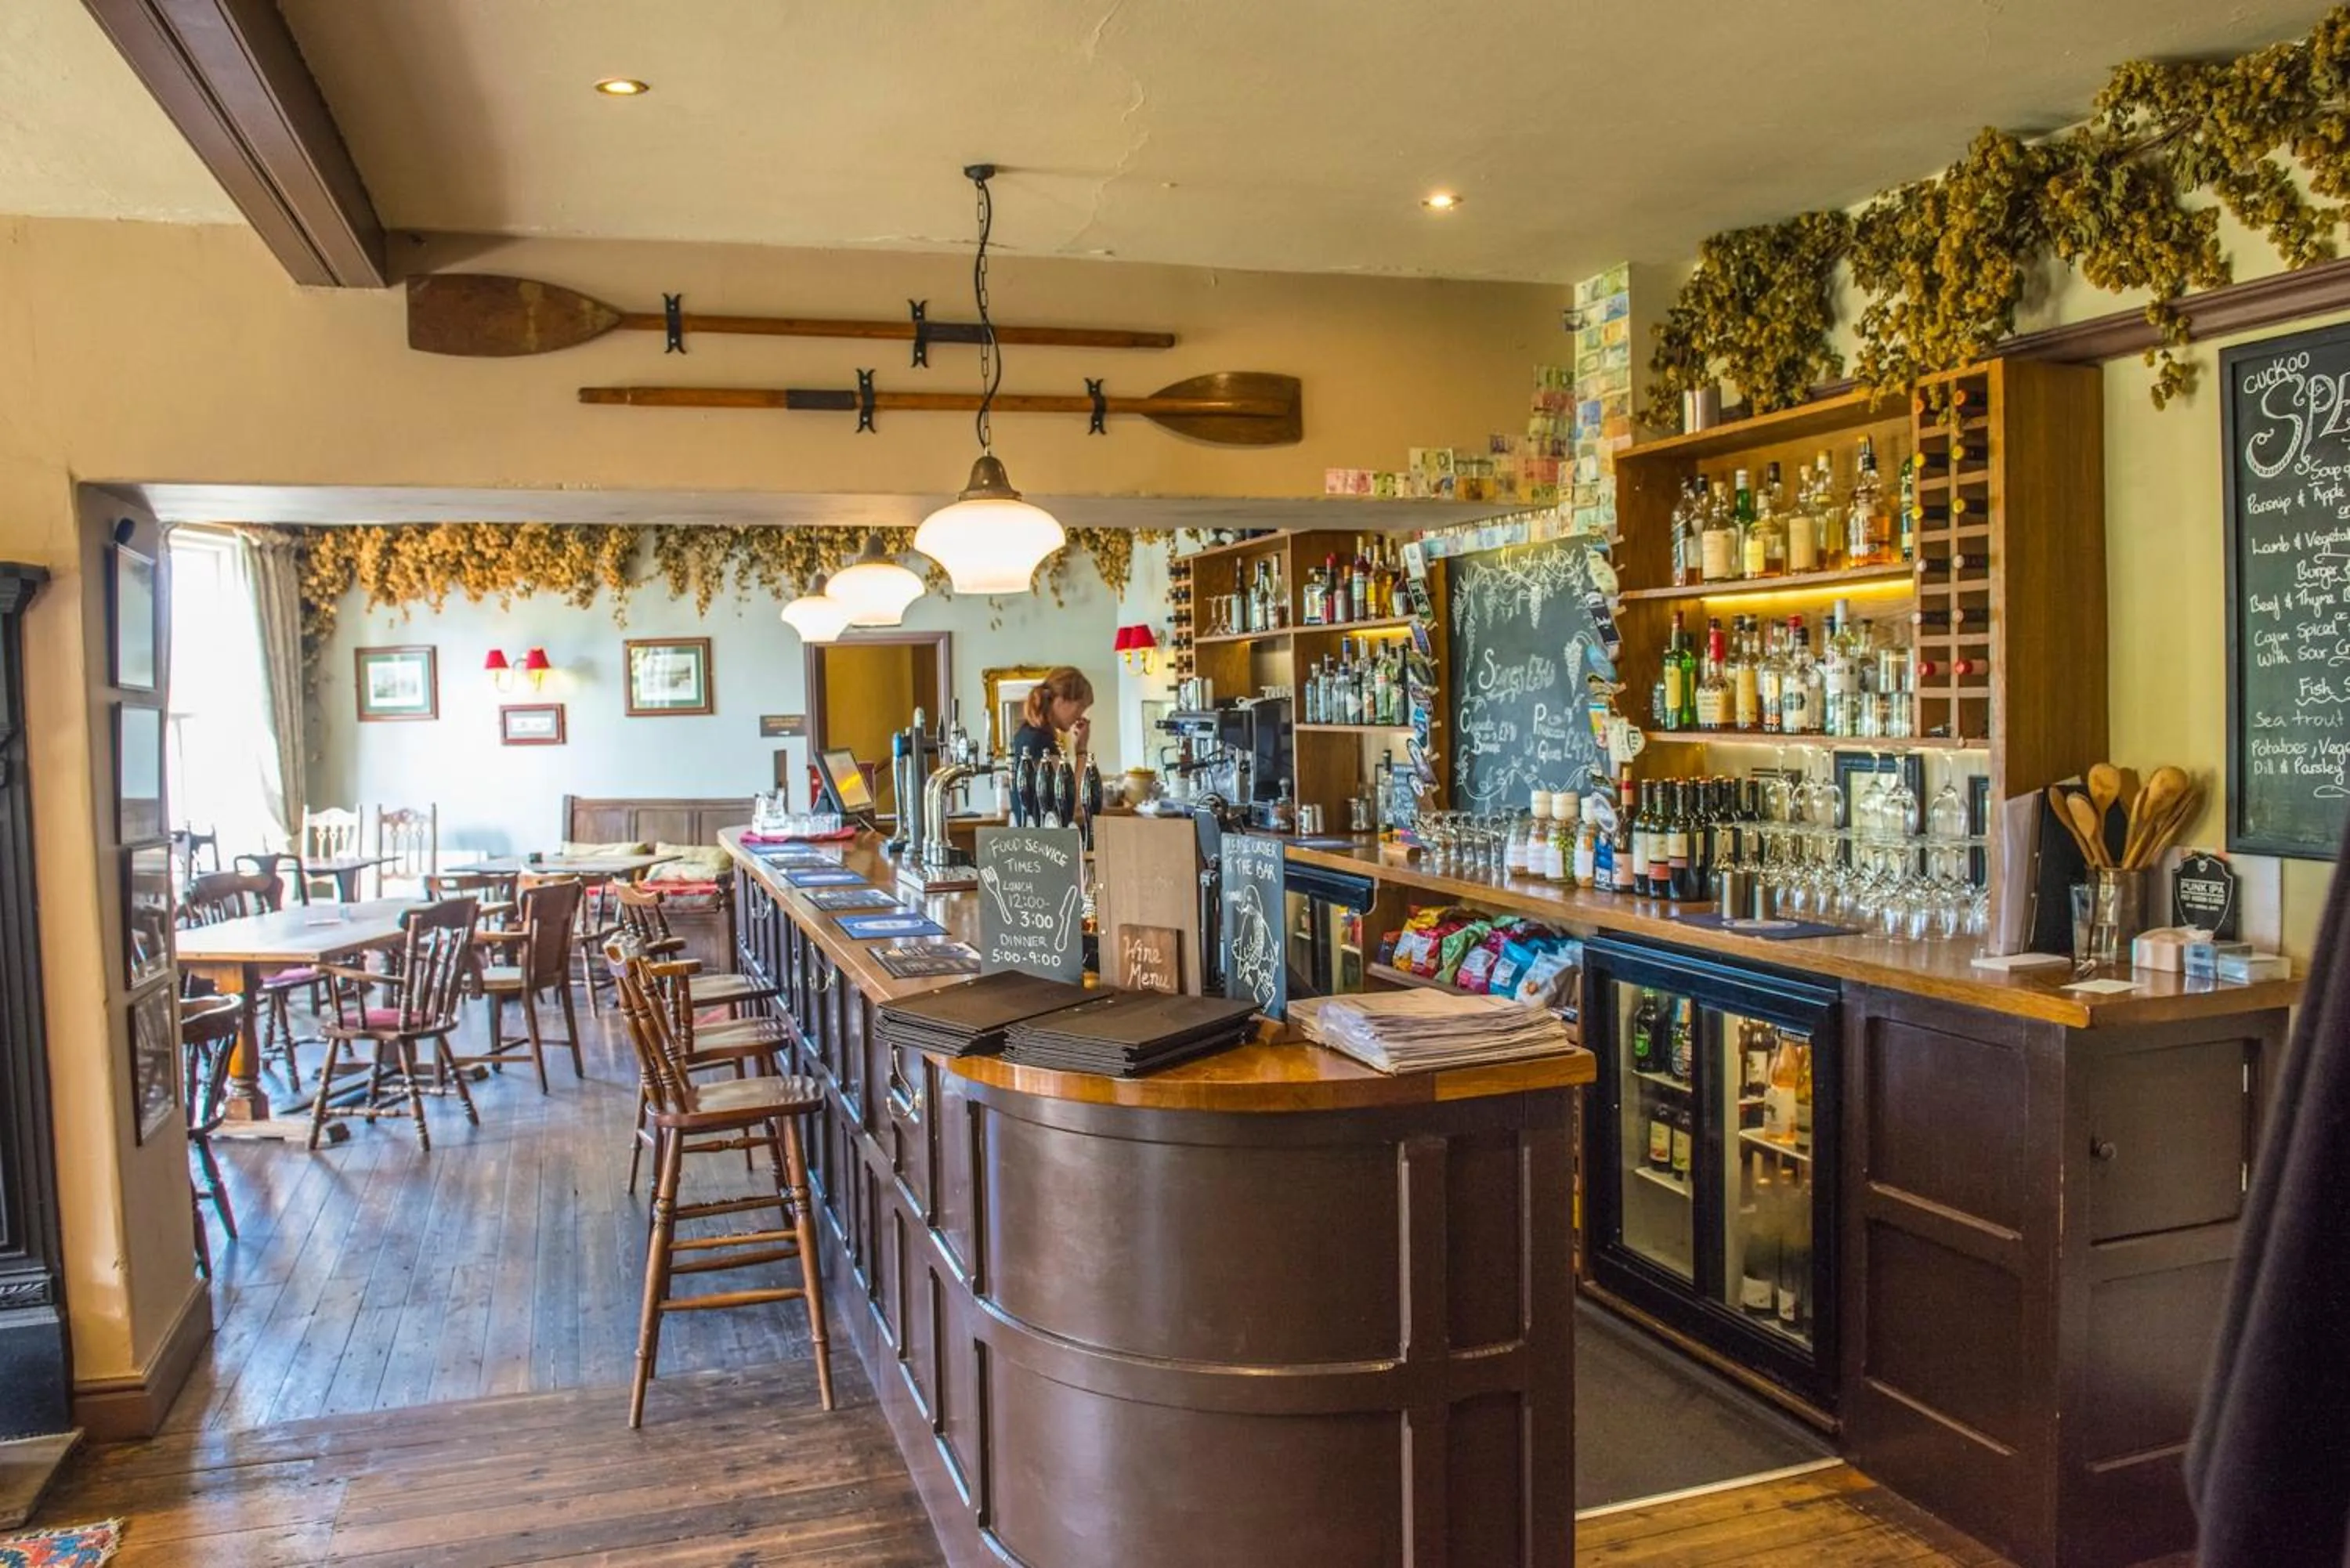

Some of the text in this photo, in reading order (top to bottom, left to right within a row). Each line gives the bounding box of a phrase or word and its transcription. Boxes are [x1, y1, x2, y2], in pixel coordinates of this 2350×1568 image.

[2247, 493, 2291, 515] Parsnip
[2313, 482, 2347, 508] Apple
[2251, 534, 2290, 555] Lamb
[2296, 559, 2338, 591] Burger
[2250, 594, 2281, 621] Beef
[2295, 588, 2337, 618] Thyme
[2297, 620, 2339, 643] Spiced
[2299, 677, 2334, 697] Fish
[2254, 708, 2344, 728] Sea trout
[2254, 758, 2274, 775] Dill
[2294, 755, 2345, 786] Parsley
[1004, 858, 1041, 873] TIMES
[1256, 860, 1278, 884] BAR
[1020, 911, 1054, 929] 3:00
[1000, 933, 1048, 948] DINNER
[1127, 963, 1170, 991] Menu
